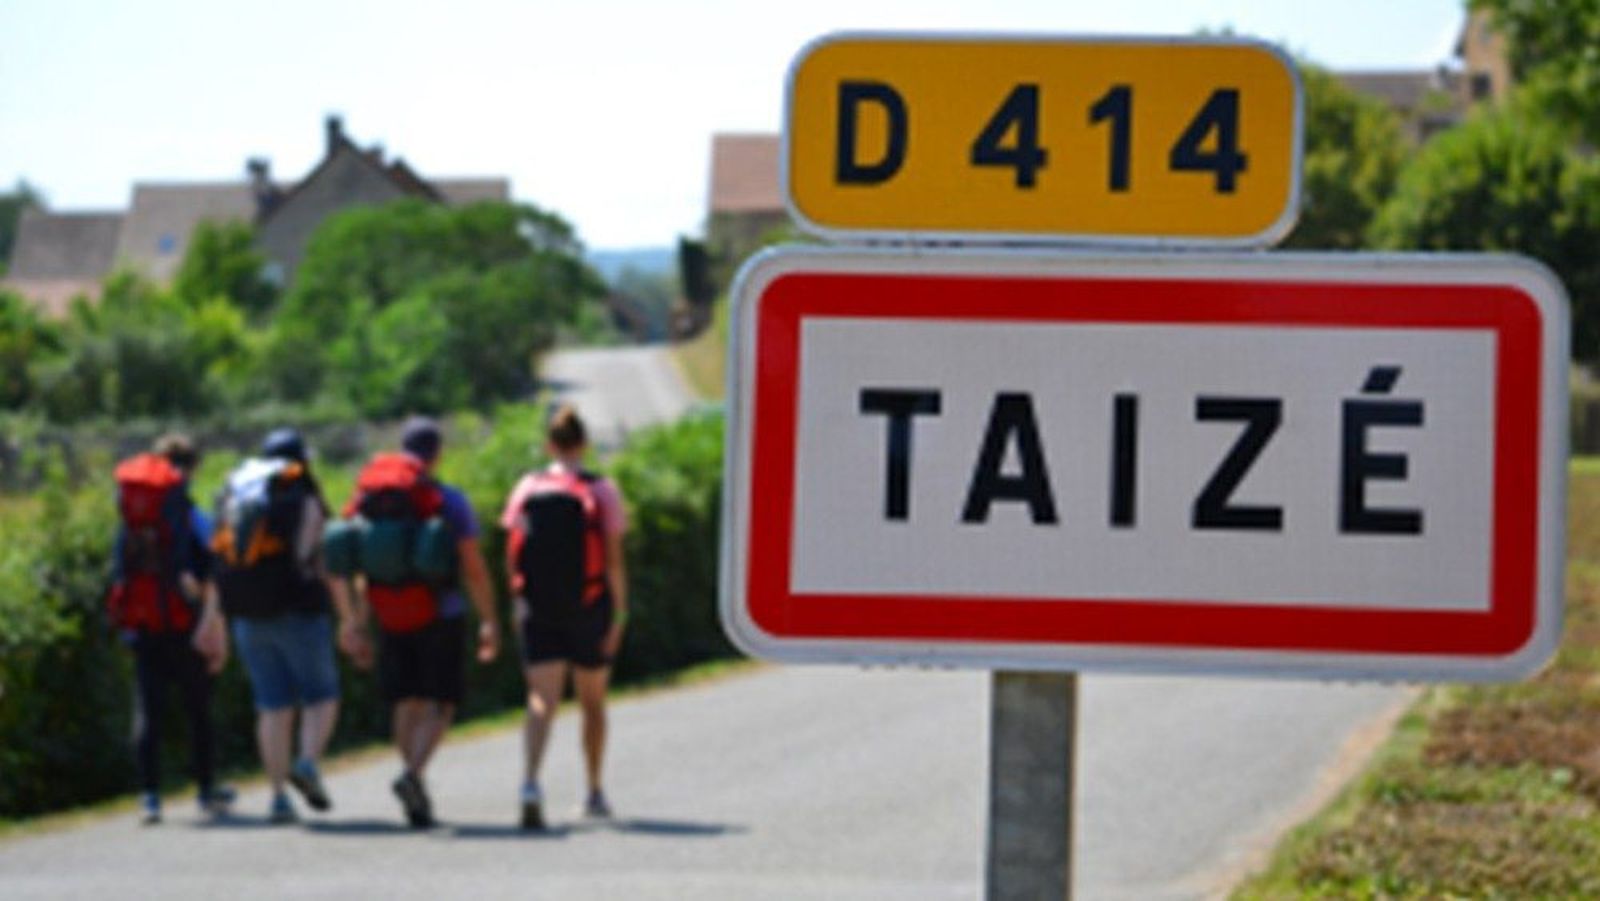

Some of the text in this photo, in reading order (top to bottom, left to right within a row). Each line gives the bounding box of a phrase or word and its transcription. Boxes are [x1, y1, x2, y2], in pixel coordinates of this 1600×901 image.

[834, 80, 1249, 193] D 414
[860, 366, 1424, 535] TAIZÉ
